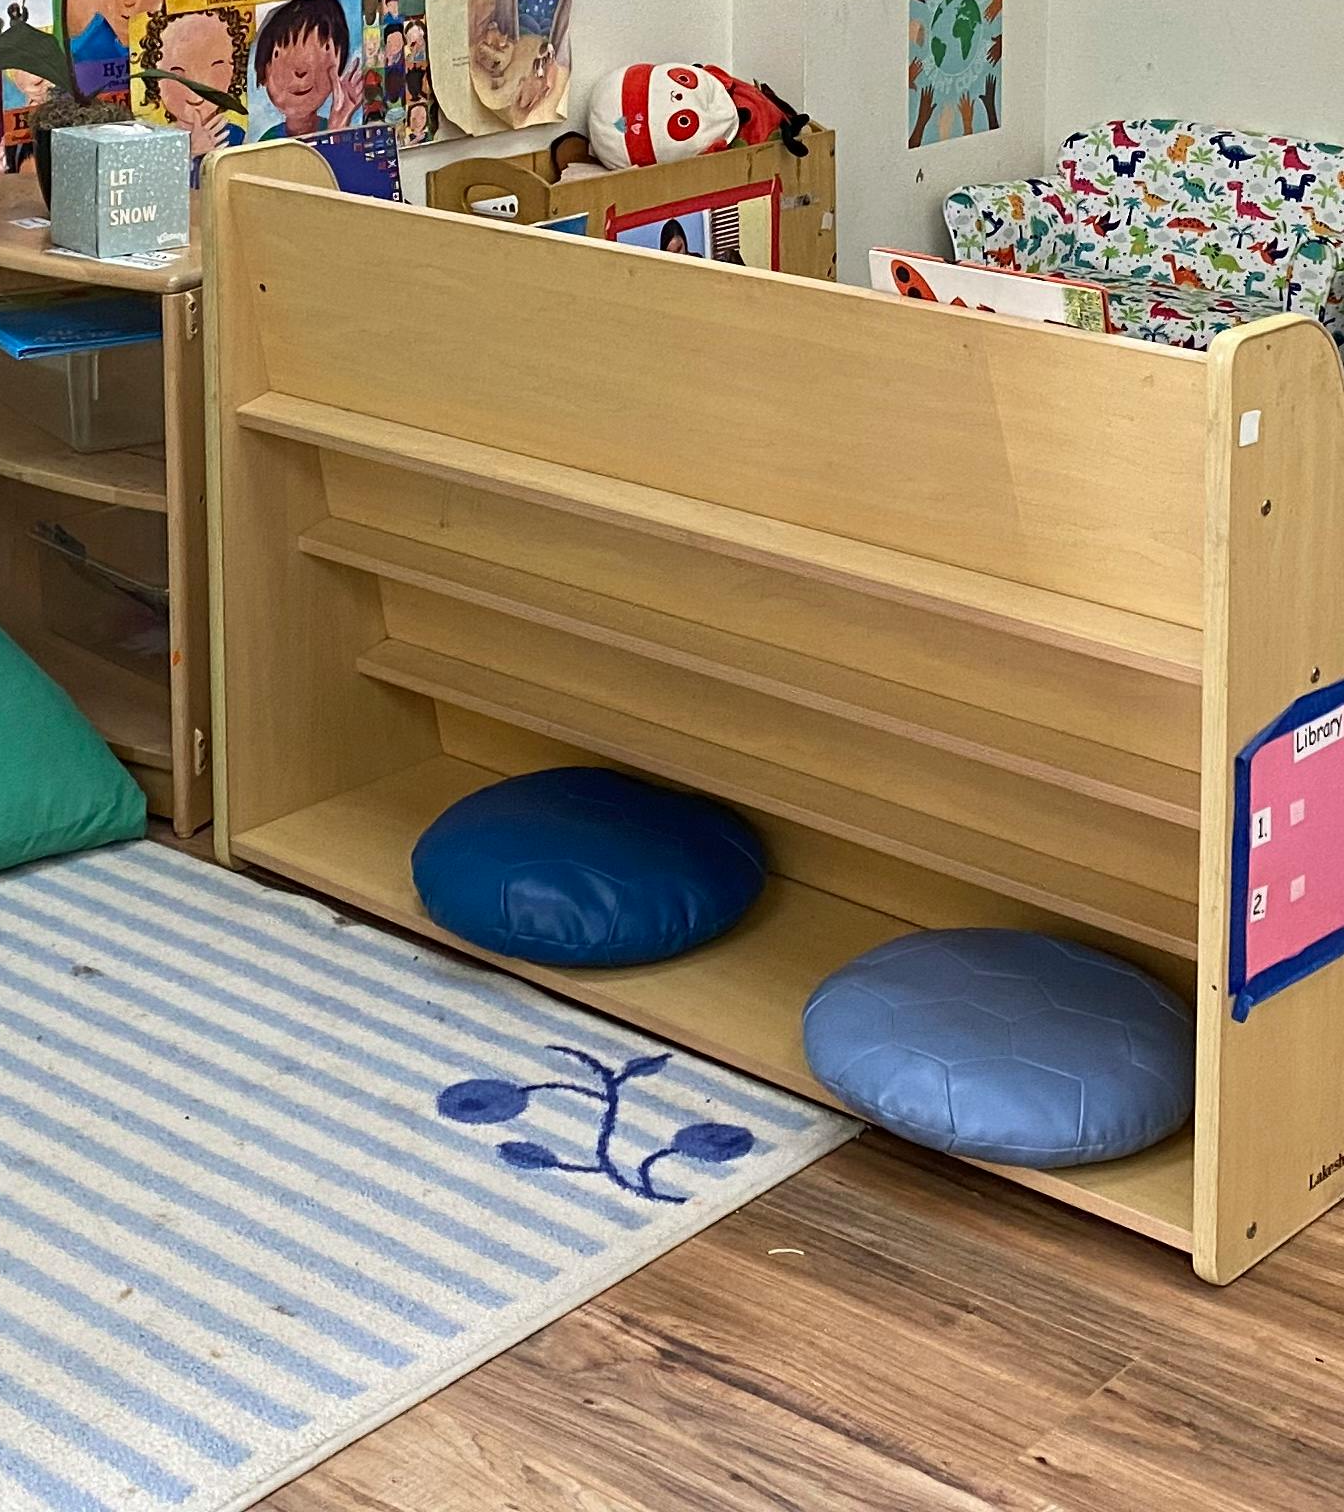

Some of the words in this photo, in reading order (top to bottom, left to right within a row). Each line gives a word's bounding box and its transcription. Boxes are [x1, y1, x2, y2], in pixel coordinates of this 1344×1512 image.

[110, 168, 135, 186] LET
[110, 189, 124, 206] IT
[110, 204, 157, 226] SNOW
[1295, 713, 1343, 754] Library
[1257, 817, 1268, 839] 1.
[1253, 893, 1265, 915] 2.
